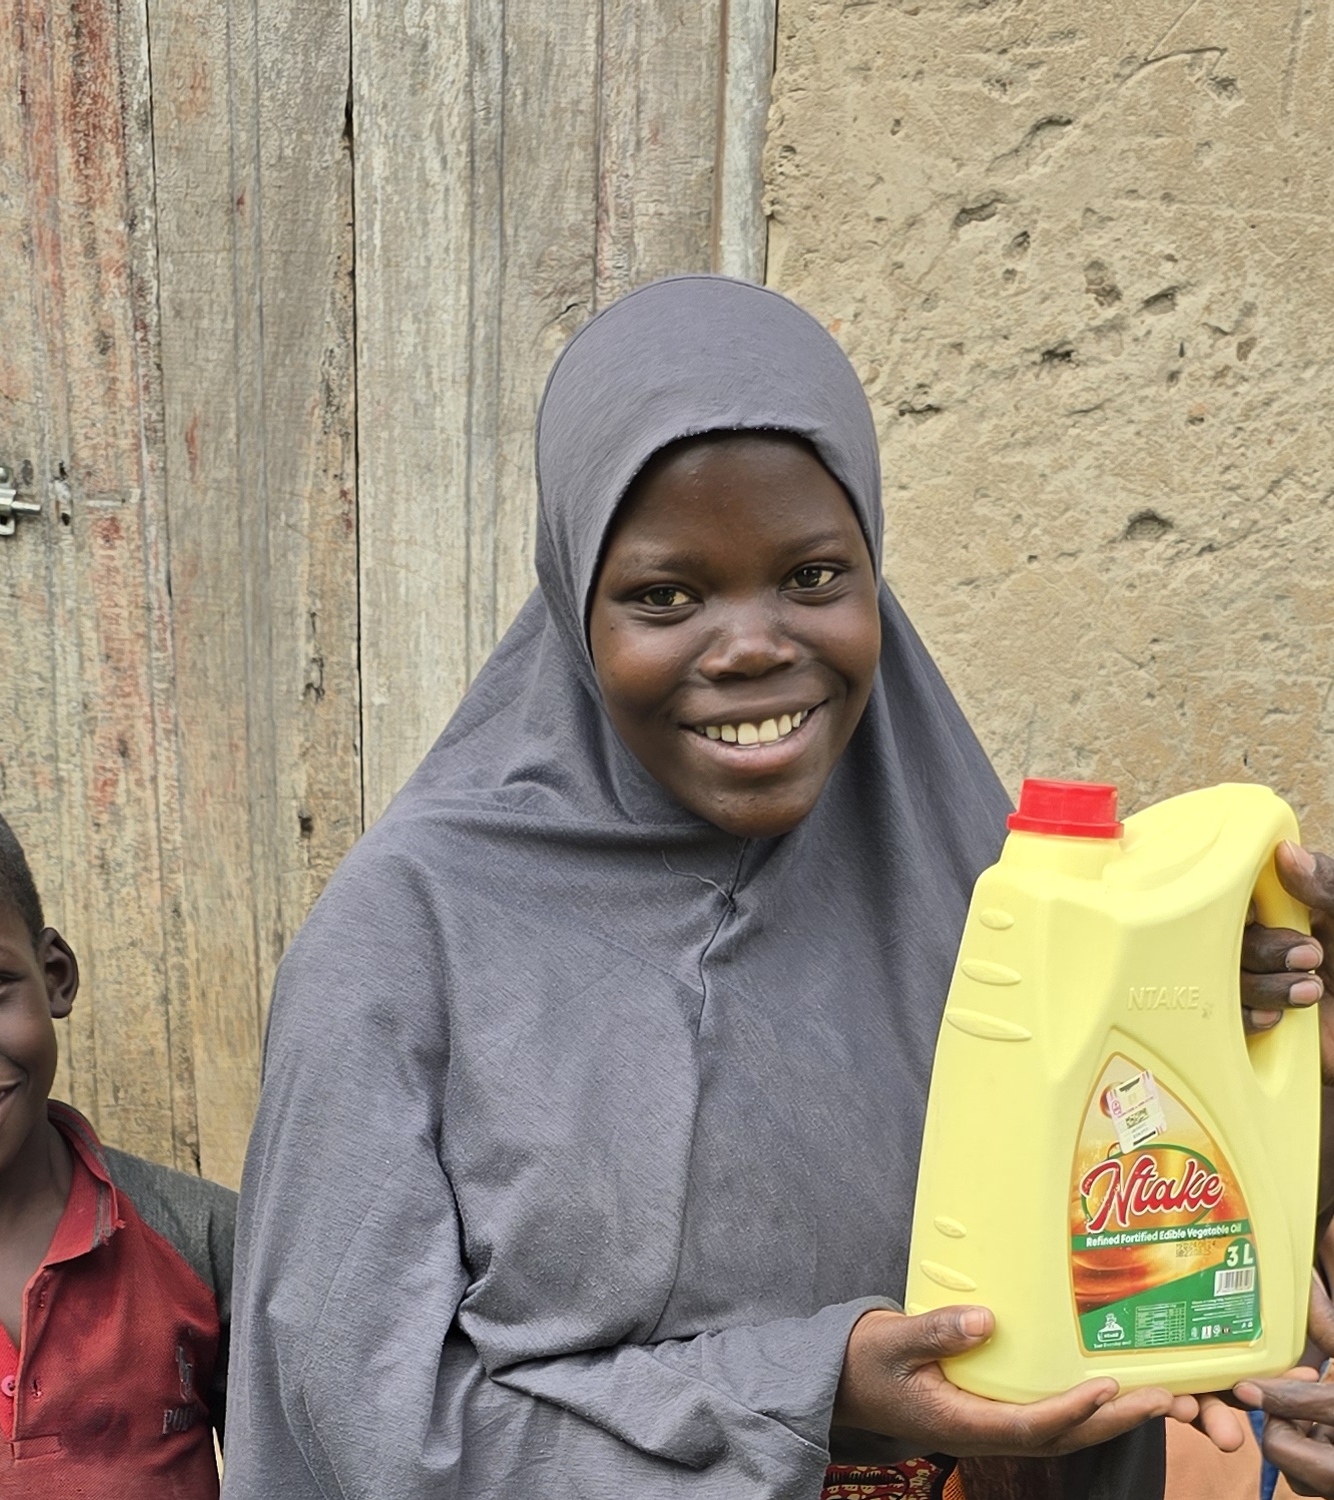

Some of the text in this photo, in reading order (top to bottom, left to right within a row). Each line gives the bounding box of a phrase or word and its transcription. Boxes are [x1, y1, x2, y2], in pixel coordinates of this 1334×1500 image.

[1127, 986, 1201, 1011] NTAKE
[1079, 1154, 1224, 1234] Ntake
[1085, 1233, 1121, 1248] Refined
[1120, 1230, 1159, 1245] Fortified
[1159, 1227, 1186, 1241] Edible
[1230, 1222, 1243, 1234] Oil
[1226, 1245, 1239, 1268] 3
[1242, 1243, 1254, 1266] L
